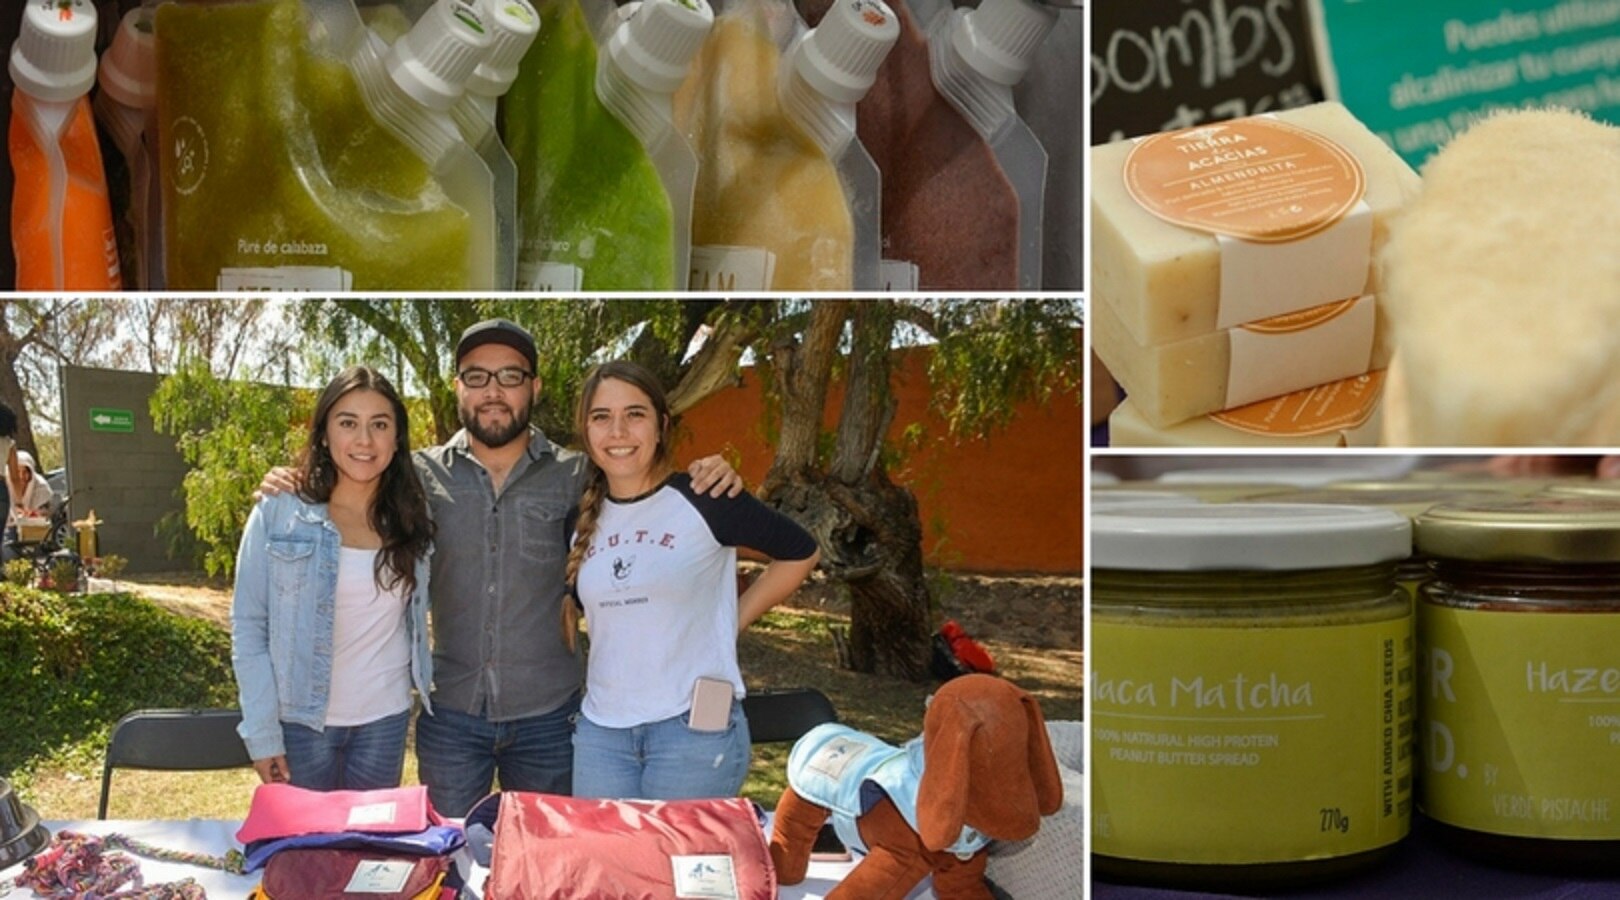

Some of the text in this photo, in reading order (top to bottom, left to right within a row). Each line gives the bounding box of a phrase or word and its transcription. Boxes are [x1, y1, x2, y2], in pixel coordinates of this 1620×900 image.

[1177, 133, 1248, 155] TIERRA
[1187, 145, 1269, 172] ACACIAS
[1189, 160, 1297, 191] ALMENDRITA
[237, 239, 328, 255] Puré de calabaza
[1170, 671, 1313, 711] Matcha
[1123, 731, 1184, 748] NATRURAL
[1188, 735, 1220, 748] HIGH
[1223, 735, 1279, 749] PROTEIN
[1384, 639, 1393, 817] WITH ADDED CHIA SEEDS
[1110, 747, 1260, 767] PEANUT BUTTER SPREAD
[1320, 808, 1349, 833] 270g
[1541, 798, 1610, 822] PISTACHE
